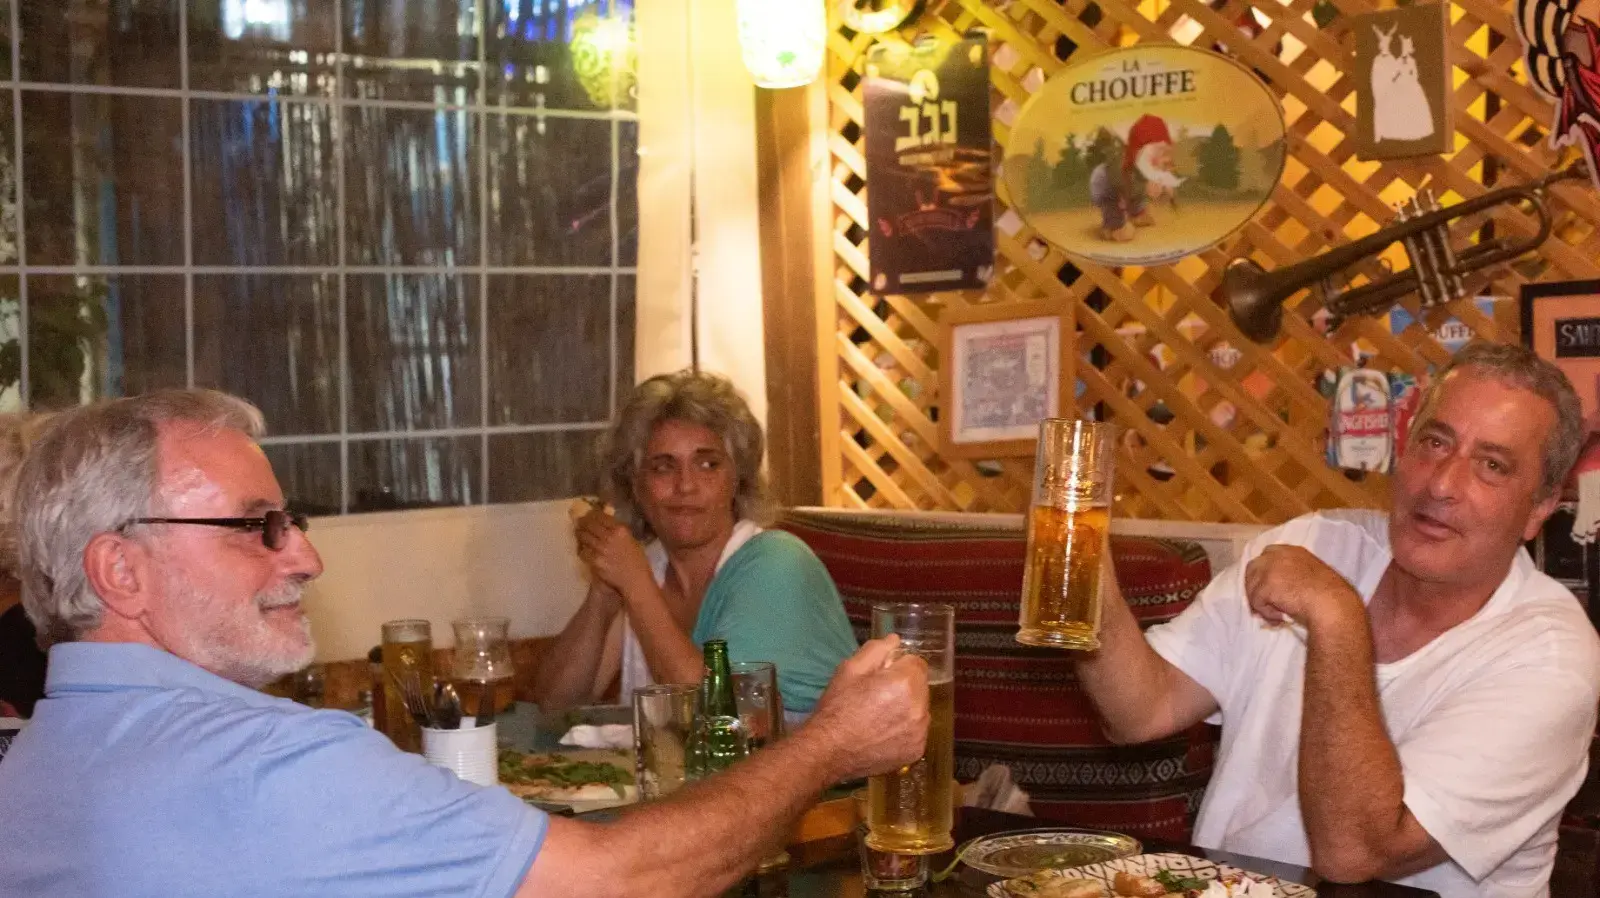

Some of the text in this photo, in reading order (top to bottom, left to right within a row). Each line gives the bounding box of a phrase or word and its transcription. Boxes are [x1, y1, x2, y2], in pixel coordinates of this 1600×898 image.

[1122, 59, 1140, 73] LA
[1070, 69, 1197, 106] CHOUFFE
[894, 101, 958, 153] נגב
